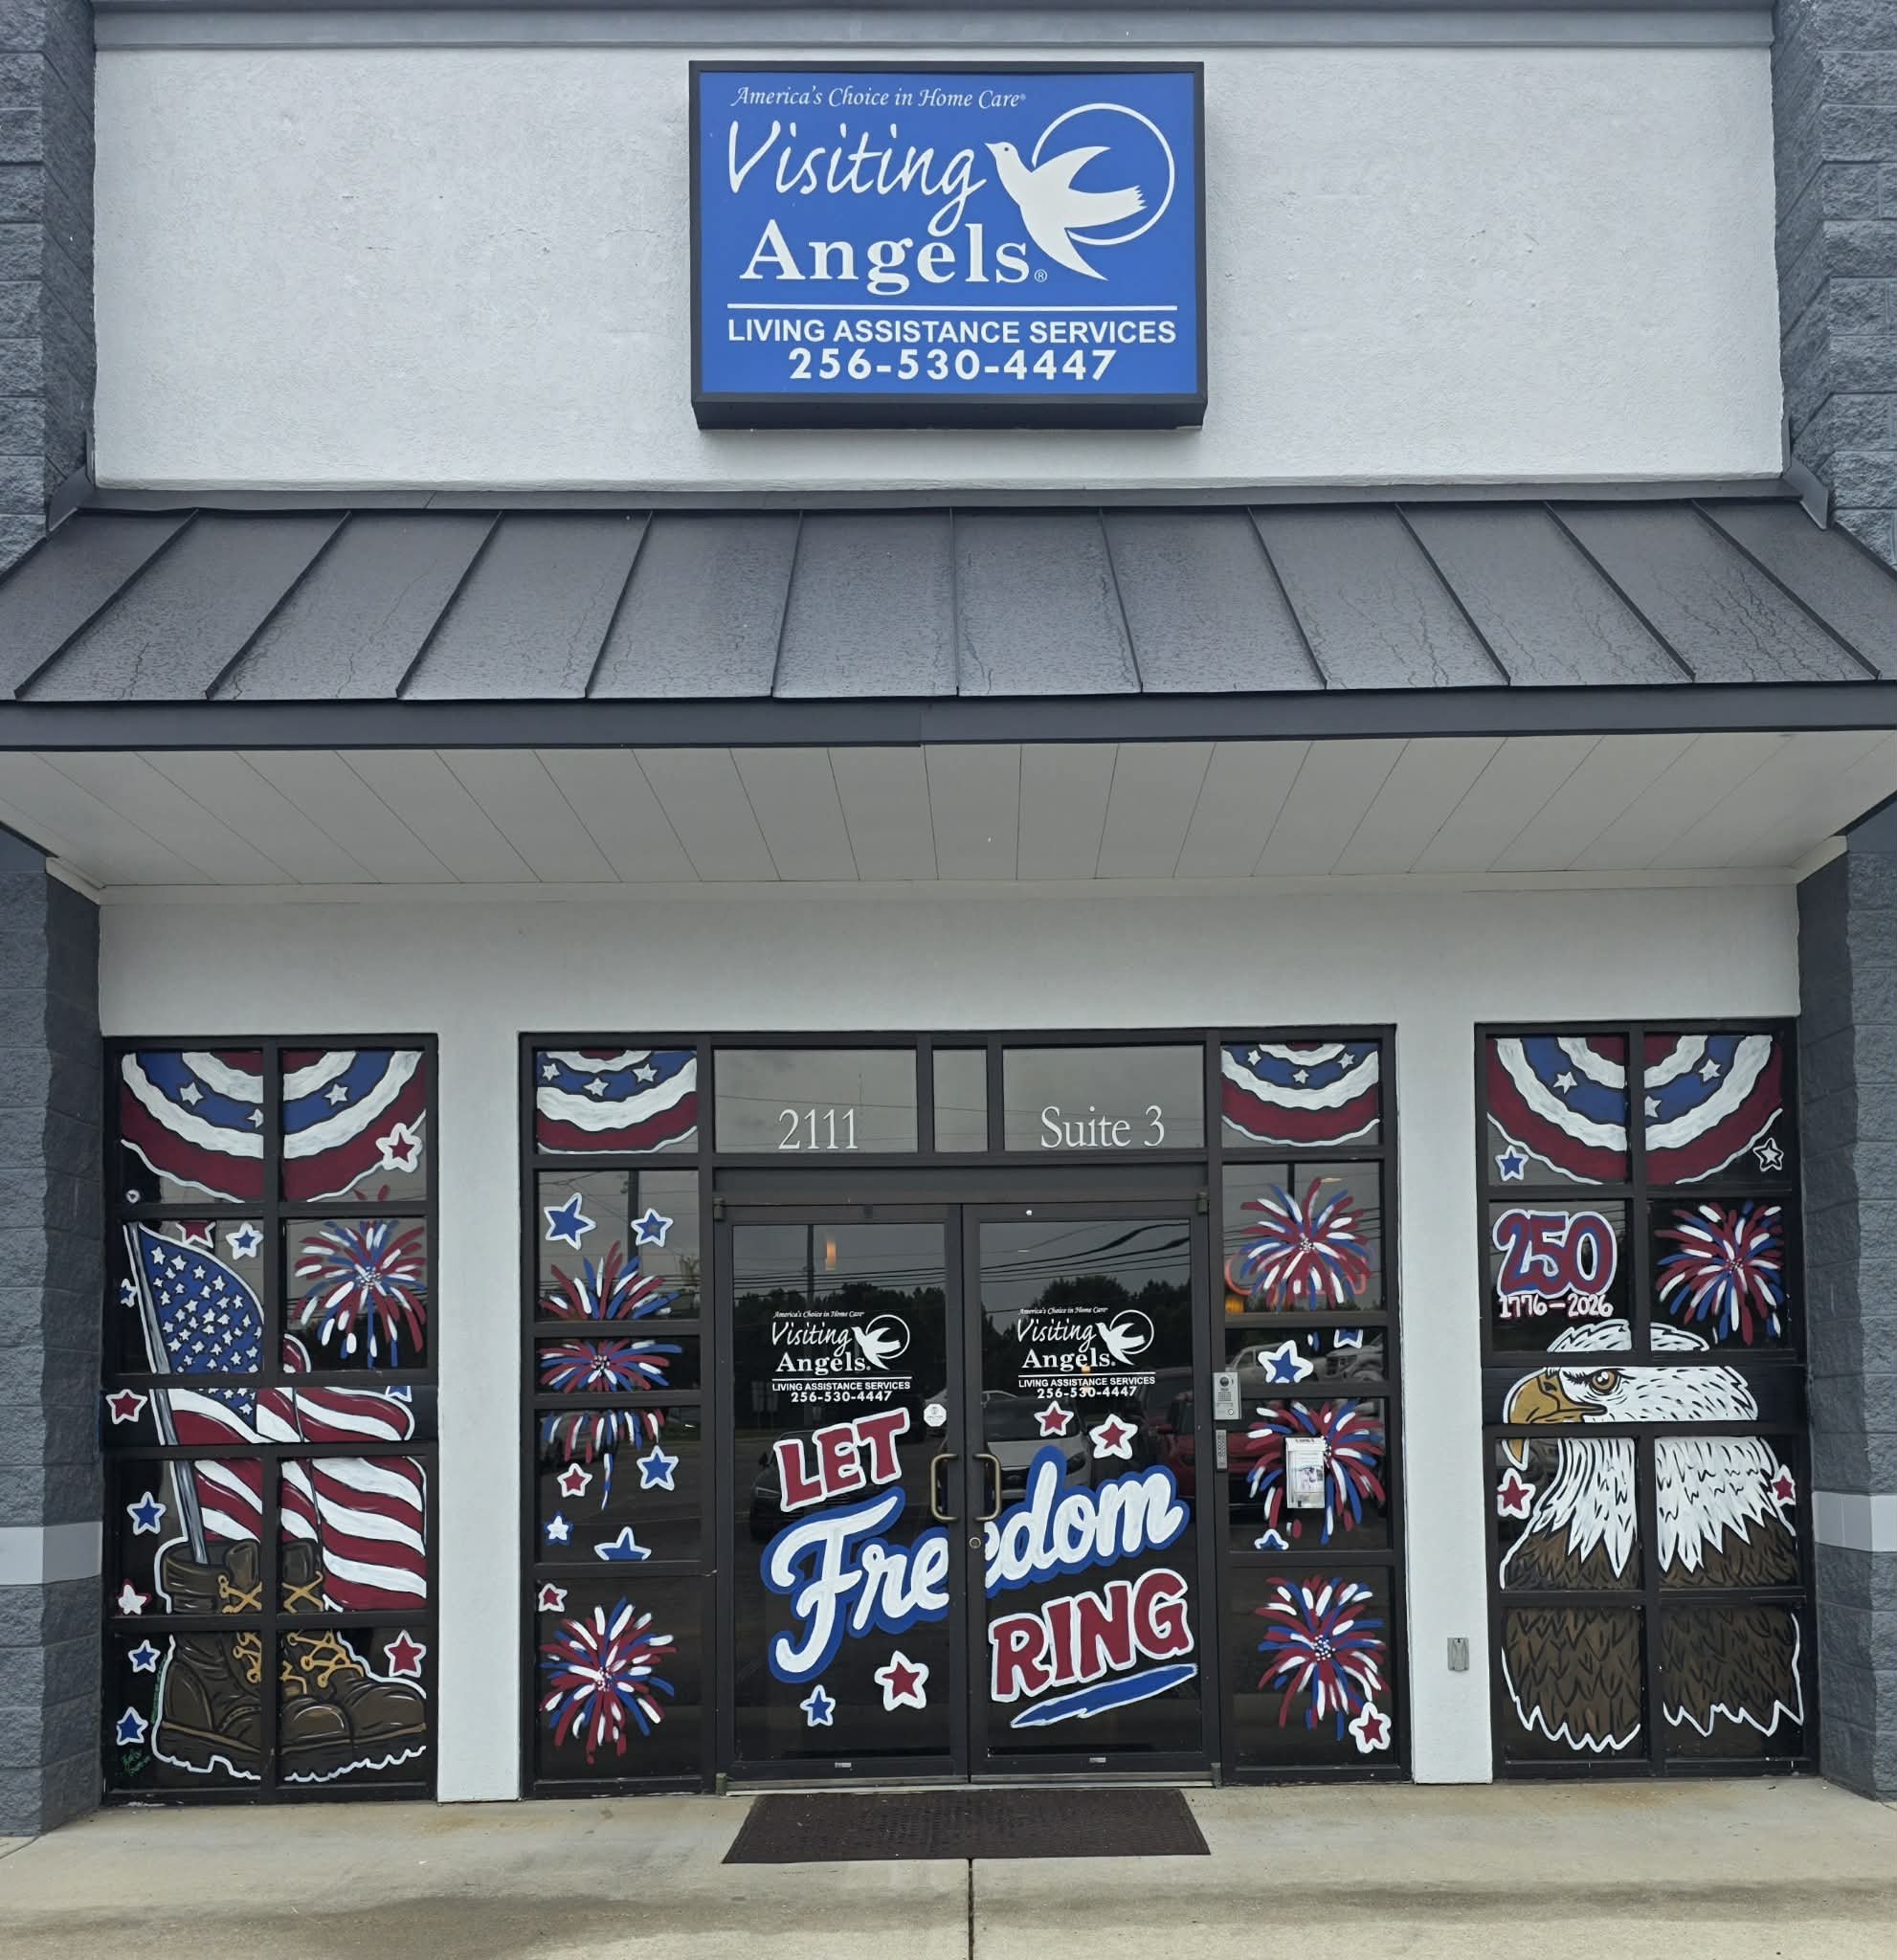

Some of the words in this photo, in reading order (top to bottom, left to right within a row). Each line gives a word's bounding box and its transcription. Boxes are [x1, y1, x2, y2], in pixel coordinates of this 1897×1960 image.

[730, 85, 822, 108] America's
[828, 84, 889, 107] Choice
[895, 86, 914, 106] in
[916, 86, 973, 107] Home
[727, 121, 987, 238] Visiting
[728, 320, 825, 343] LIVING
[833, 320, 1020, 344] ASSISTANCE
[1029, 321, 1176, 345] SERVICES
[789, 347, 1117, 381] 256-530-4447
[778, 1108, 859, 1149] 2111
[1040, 1105, 1131, 1148] Suite
[1144, 1104, 1165, 1147] 3
[1492, 1209, 1618, 1299] 250
[1498, 1293, 1615, 1319] 1776-2026
[772, 1321, 853, 1357] Visiting
[1017, 1318, 1097, 1353] Visiting
[772, 1382, 803, 1392] LIVING
[804, 1382, 862, 1392] ASSISTANCE
[864, 1381, 911, 1391] SERVICES
[791, 1391, 894, 1403] 256-530-4447
[1018, 1379, 1049, 1388] LIVING
[1050, 1377, 1108, 1388] ASSISTANCE
[1110, 1376, 1155, 1386] SERVICES
[1037, 1386, 1138, 1399] 256-530-4447
[773, 1407, 910, 1512] LET
[989, 1569, 1194, 1702] RING
